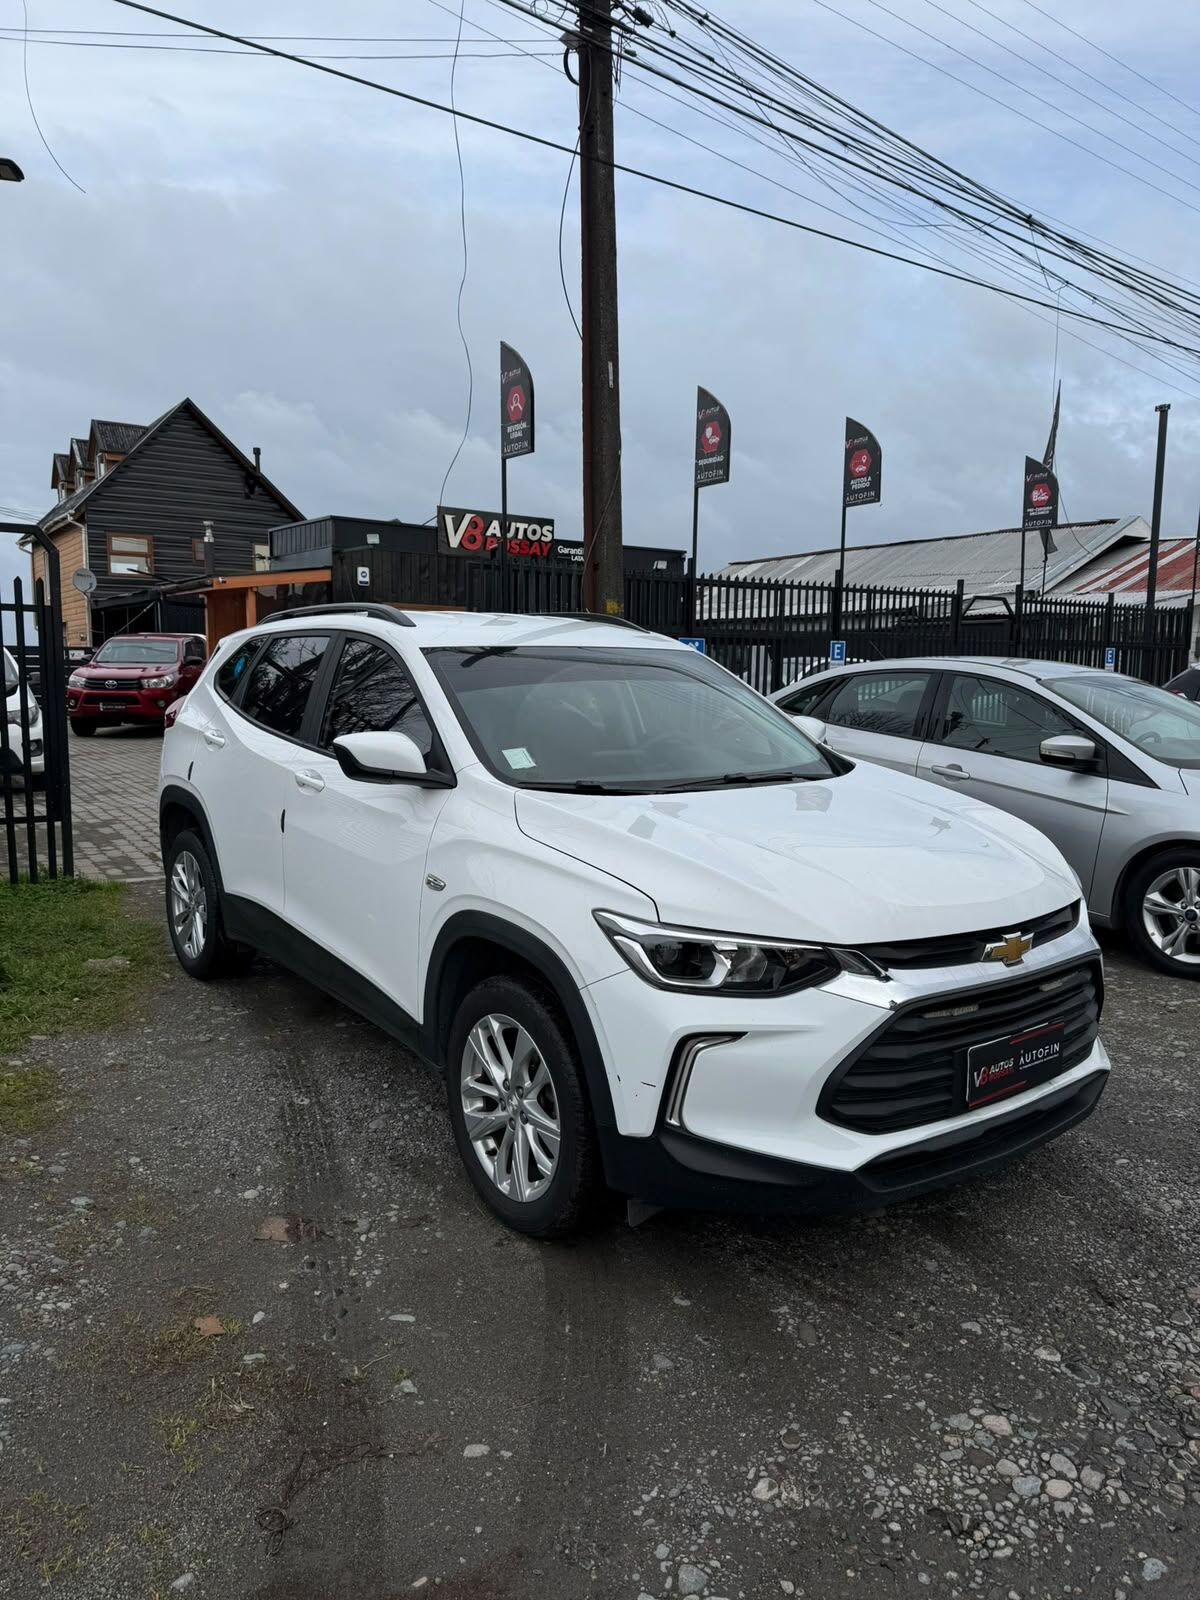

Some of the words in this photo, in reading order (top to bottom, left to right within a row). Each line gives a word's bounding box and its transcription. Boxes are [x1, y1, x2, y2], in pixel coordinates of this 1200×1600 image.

[503, 440, 529, 453] AUTOFIN
[696, 468, 724, 480] AUTOFIN
[850, 477, 867, 485] AUTOS
[851, 481, 870, 490] PEDIDO
[846, 490, 875, 501] AUTOFIN
[1025, 519, 1053, 527] AUTOFIN
[444, 513, 485, 550] V8
[485, 519, 553, 542] AUTOS
[485, 536, 552, 557] BSSAY
[834, 644, 842, 659] E
[989, 1057, 1014, 1073] AUTOS
[1019, 1042, 1060, 1066] AUTOFIN
